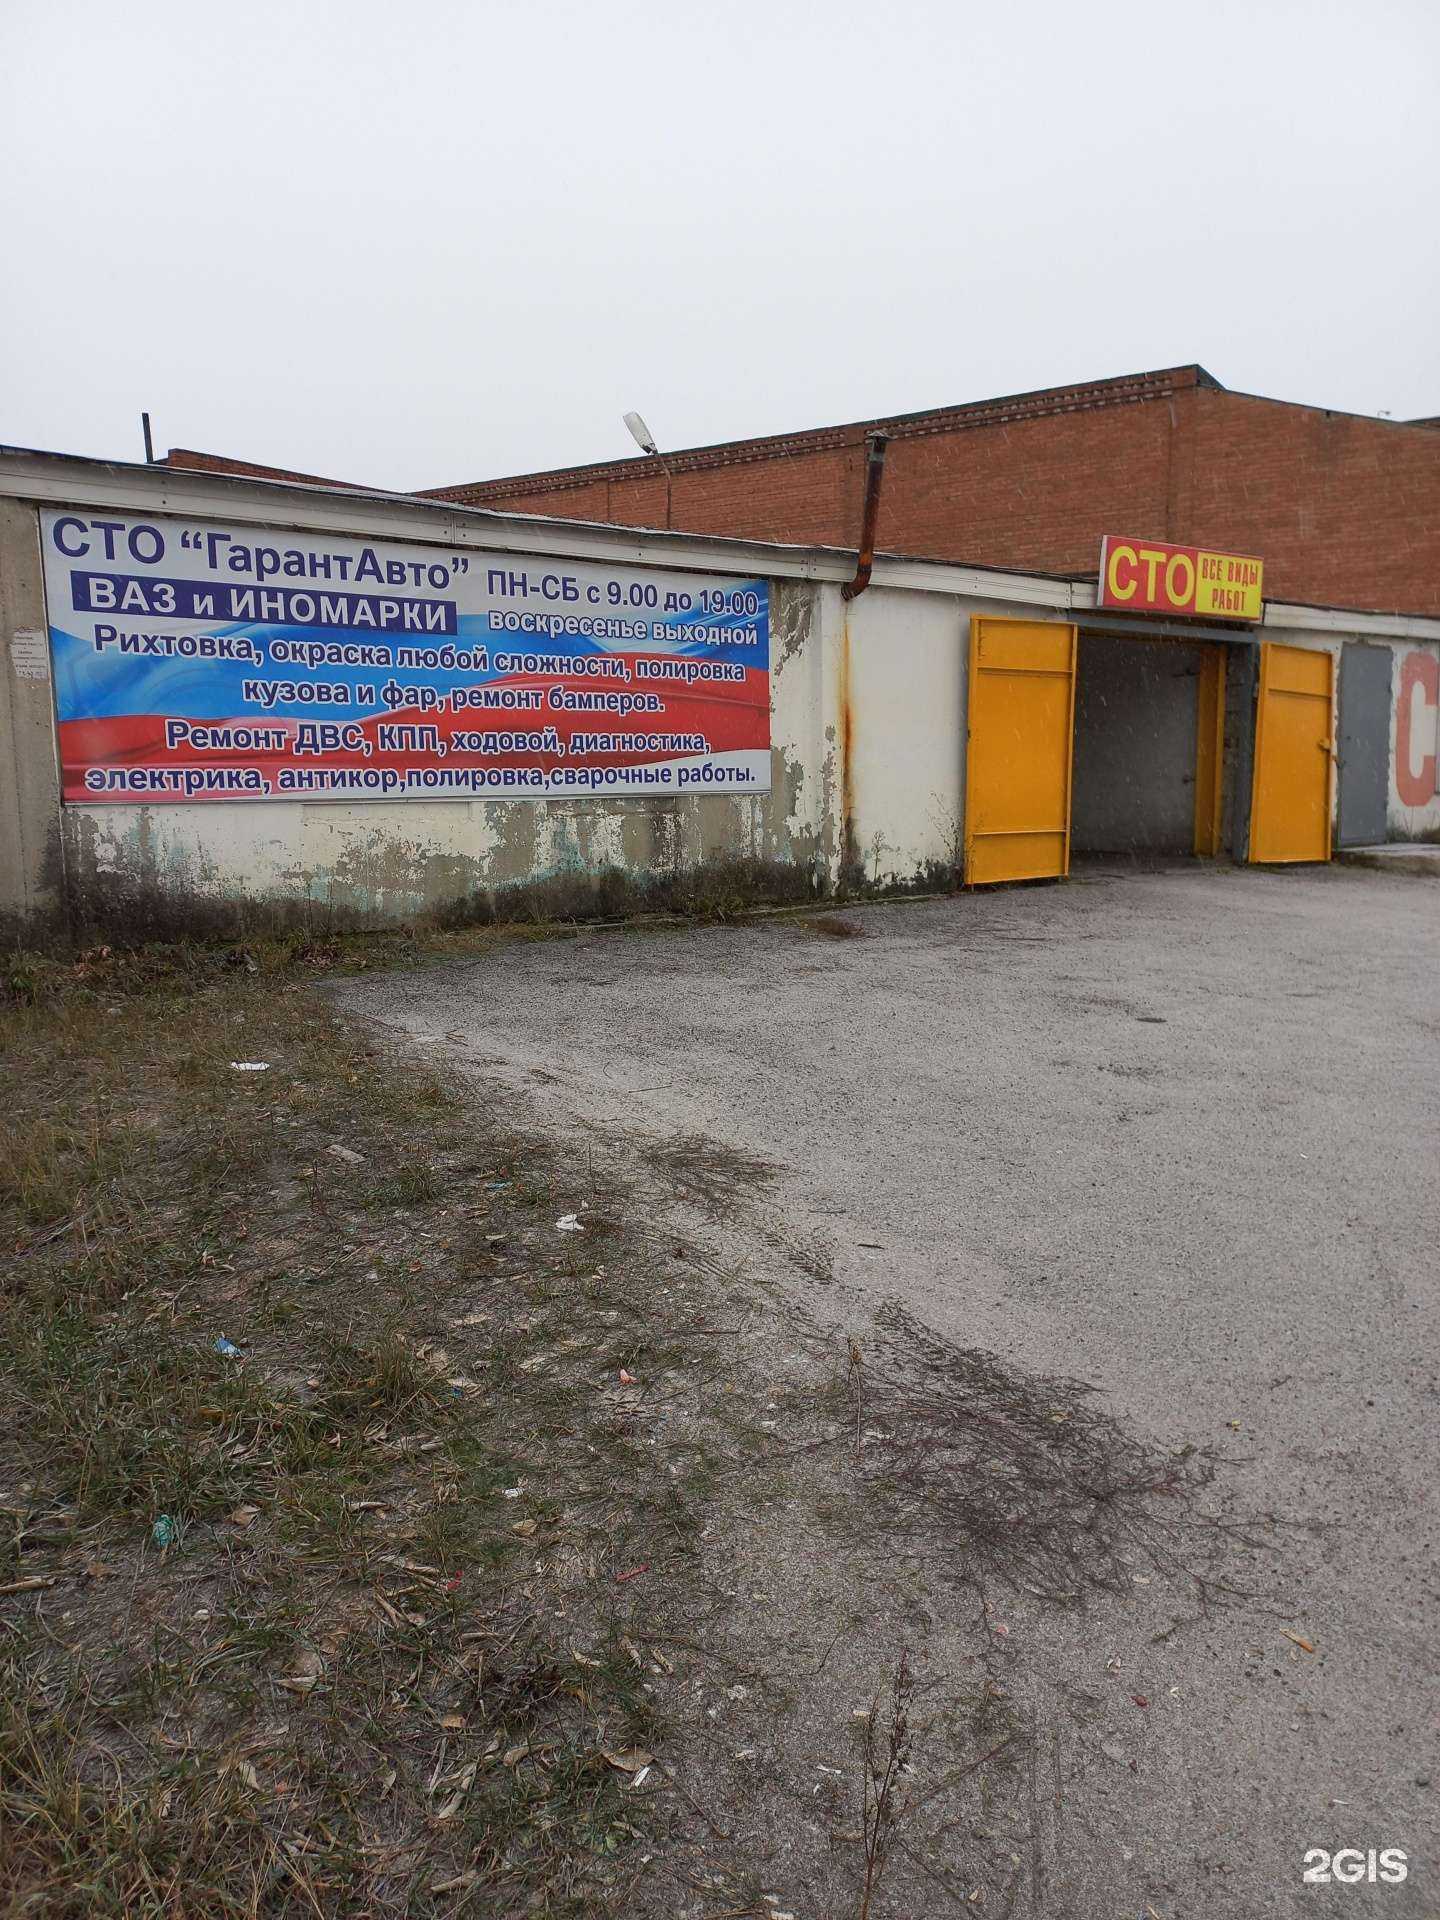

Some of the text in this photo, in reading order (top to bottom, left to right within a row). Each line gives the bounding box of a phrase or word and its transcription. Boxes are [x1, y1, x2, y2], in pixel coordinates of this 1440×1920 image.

[53, 517, 165, 564] СТО
[1108, 546, 1195, 606] СТО
[1202, 558, 1258, 588] ВСЕ ВИДЫ
[88, 577, 447, 632] ВАЗ и ИНОМАРКИ
[487, 569, 758, 616] ПН-СБ с 9.00 до 19.00
[1212, 588, 1246, 611] РАБОТ
[489, 609, 757, 645] воскресенье выходной
[94, 624, 745, 685] Рихтовка, окраска любой сложности, полировка
[243, 679, 665, 714] кузова и фар, ремонт бамперов.
[166, 720, 711, 757] Ремонт ДВС, КПП, ходовой, диагностика,
[85, 767, 271, 795] электрика,
[677, 763, 756, 785] работы.
